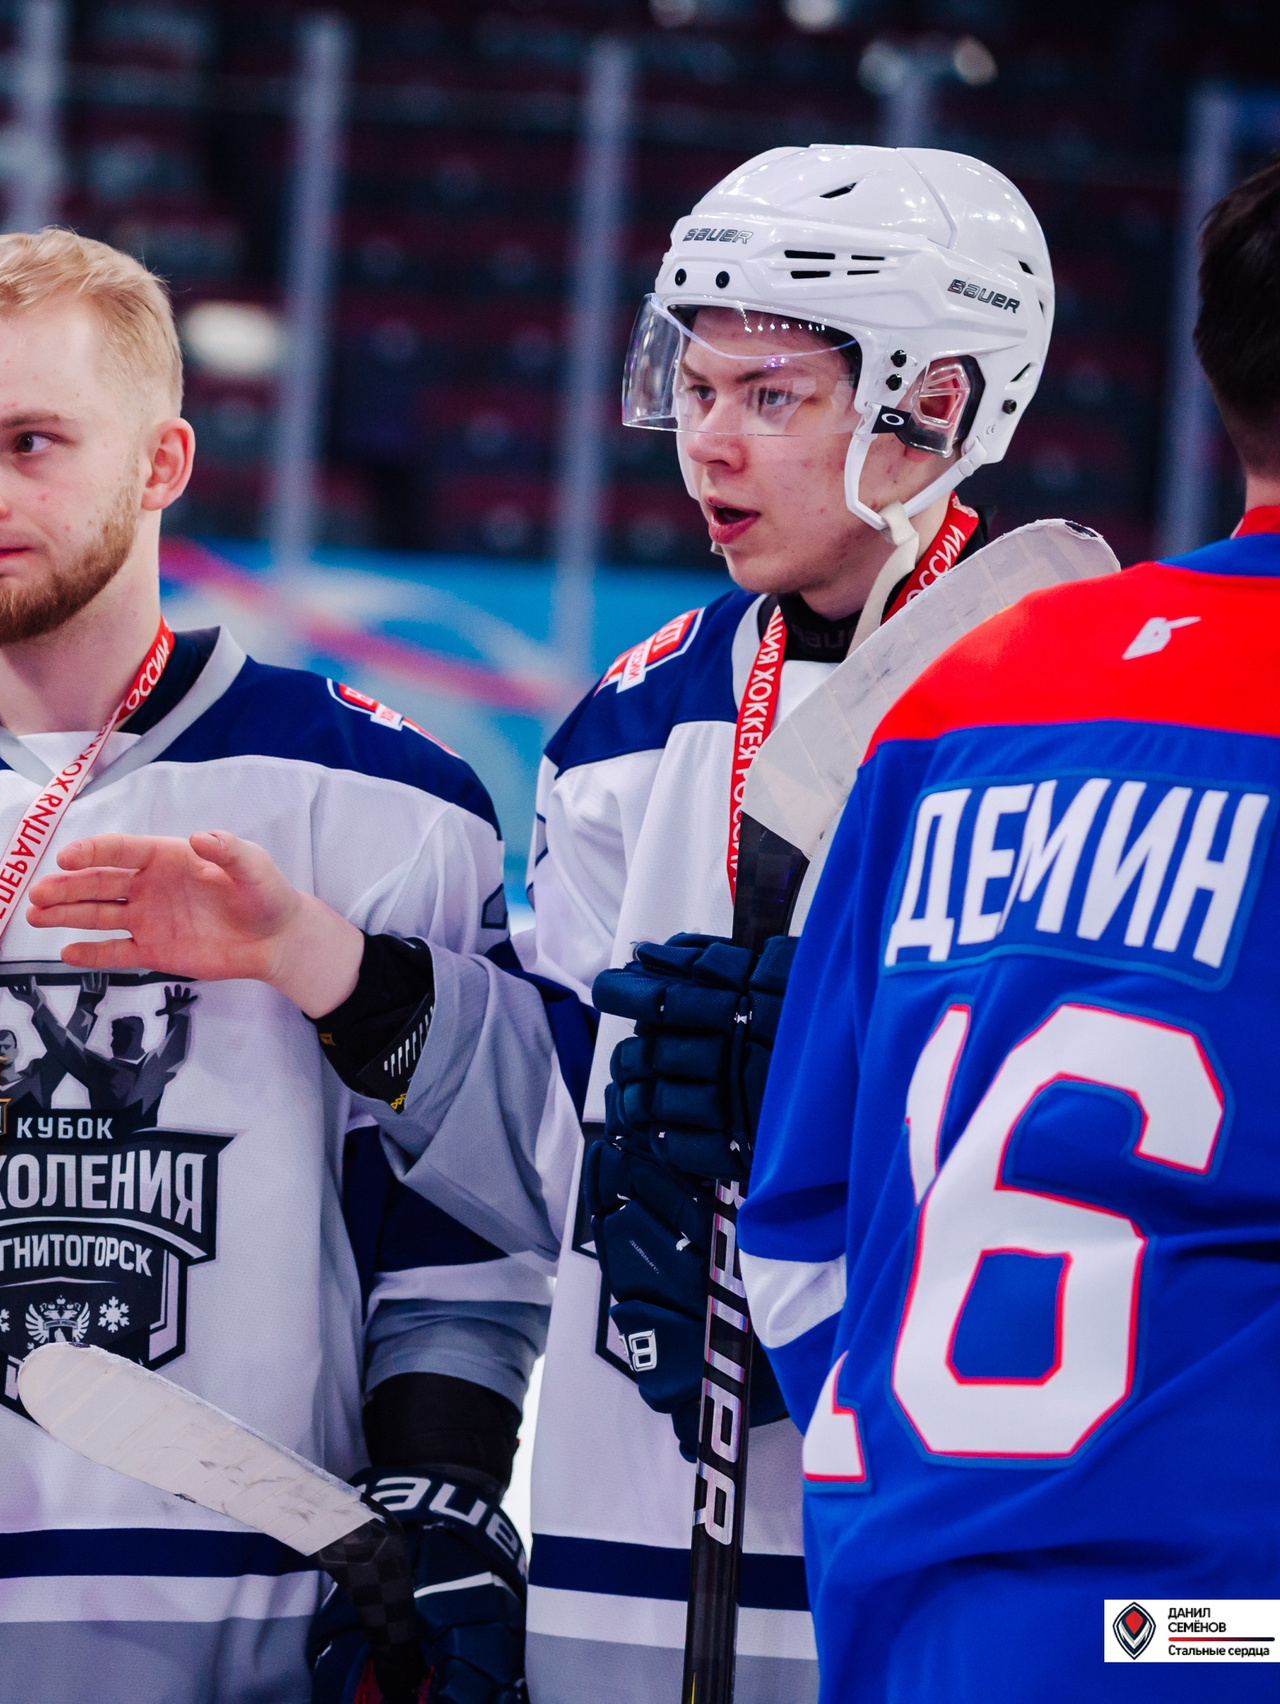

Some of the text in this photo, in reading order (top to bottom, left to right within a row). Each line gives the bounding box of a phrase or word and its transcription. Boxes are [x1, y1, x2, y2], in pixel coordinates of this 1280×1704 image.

[947, 279, 1021, 314] BAUER
[906, 524, 966, 604] ССИИ
[126, 635, 170, 711] ОССИИ
[885, 778, 1271, 969] ДЕМИН
[16, 1117, 113, 1139] КУБОК
